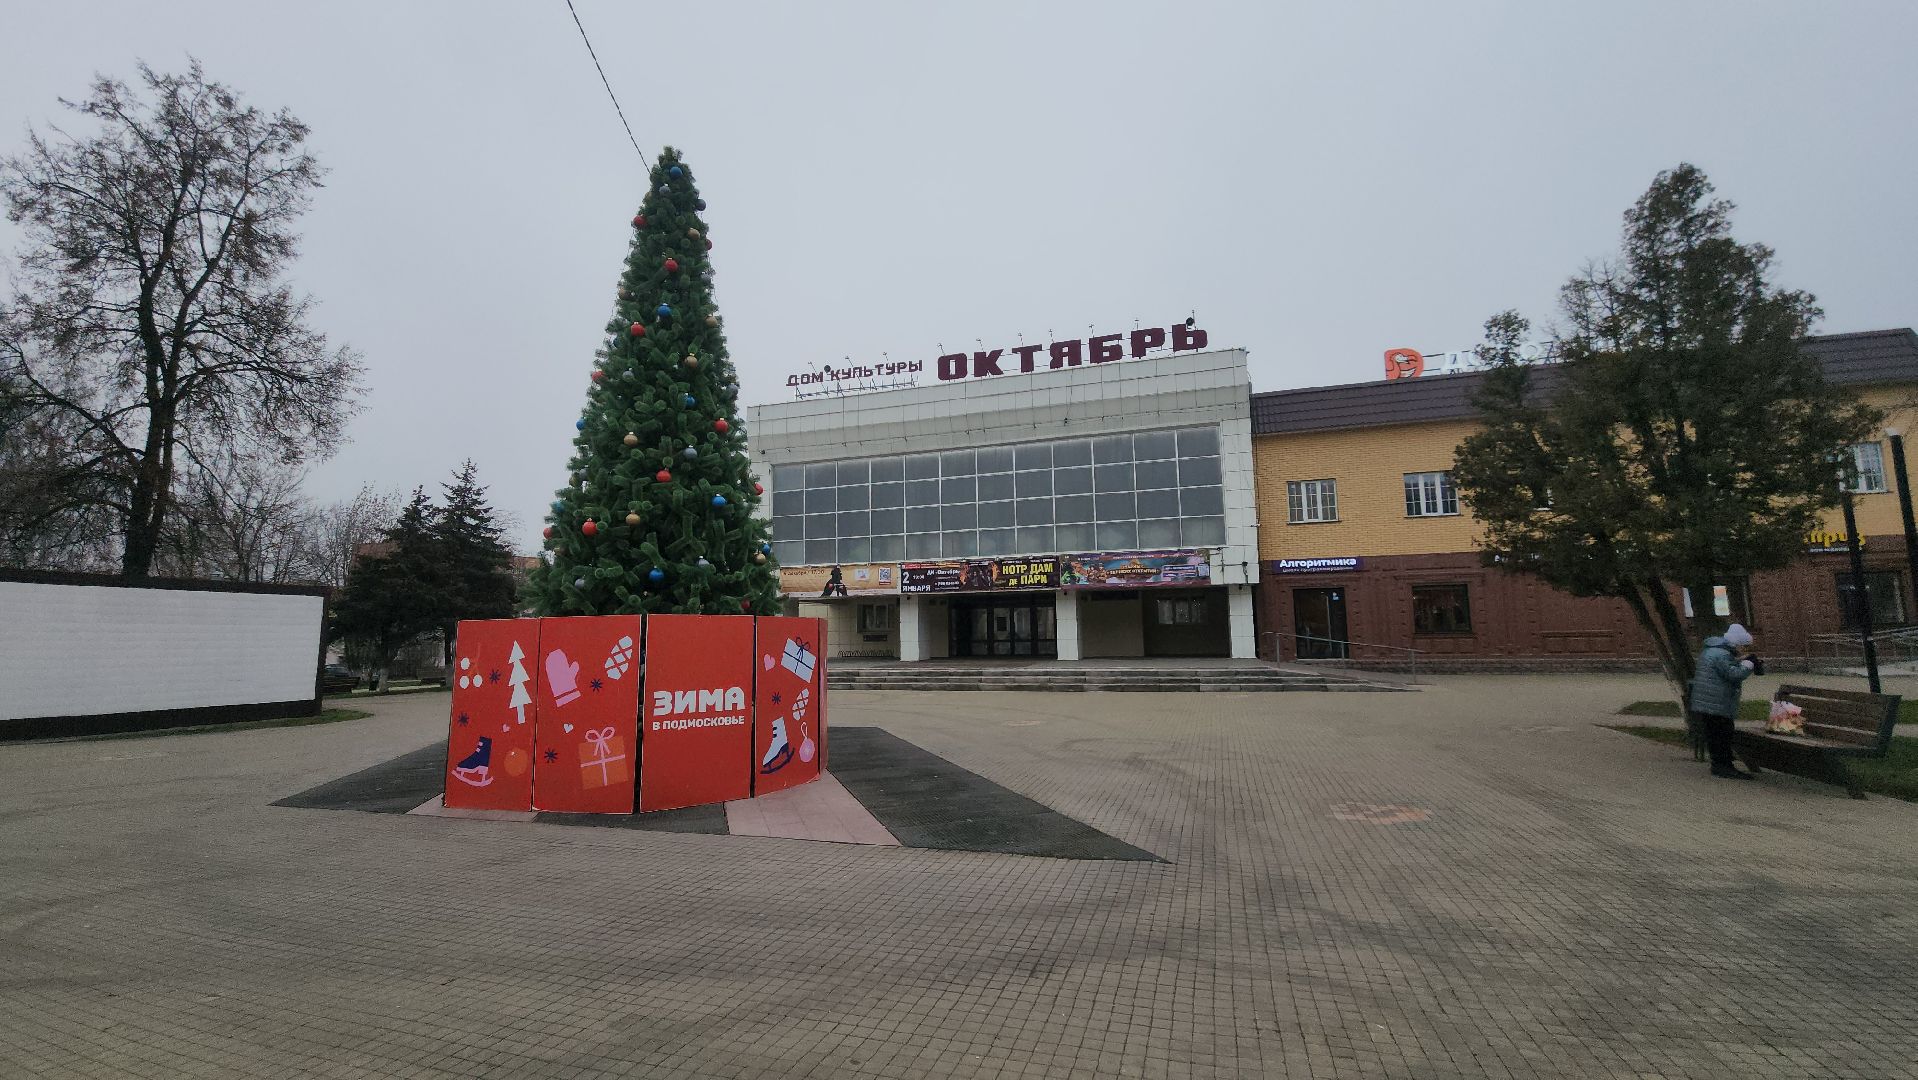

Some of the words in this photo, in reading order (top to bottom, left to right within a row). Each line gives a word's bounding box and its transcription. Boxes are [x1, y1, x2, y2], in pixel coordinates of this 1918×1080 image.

[937, 323, 1208, 381] ОКТЯБРЬ
[786, 370, 824, 387] ДОМ
[831, 359, 923, 381] КУЛЬТУРЫ
[1002, 565, 1027, 575] НОТР
[1029, 563, 1053, 574] ДАМ
[1279, 559, 1357, 568] Алгоритмика
[902, 571, 910, 584] 2
[1008, 578, 1018, 586] ДЕ
[1020, 574, 1048, 584] ПАРИ
[902, 584, 931, 592] ЯНВАРЯ
[653, 687, 746, 716] ЗИМА
[652, 722, 660, 731] В
[662, 716, 745, 730] ПОДМОСКОВЬЕ
